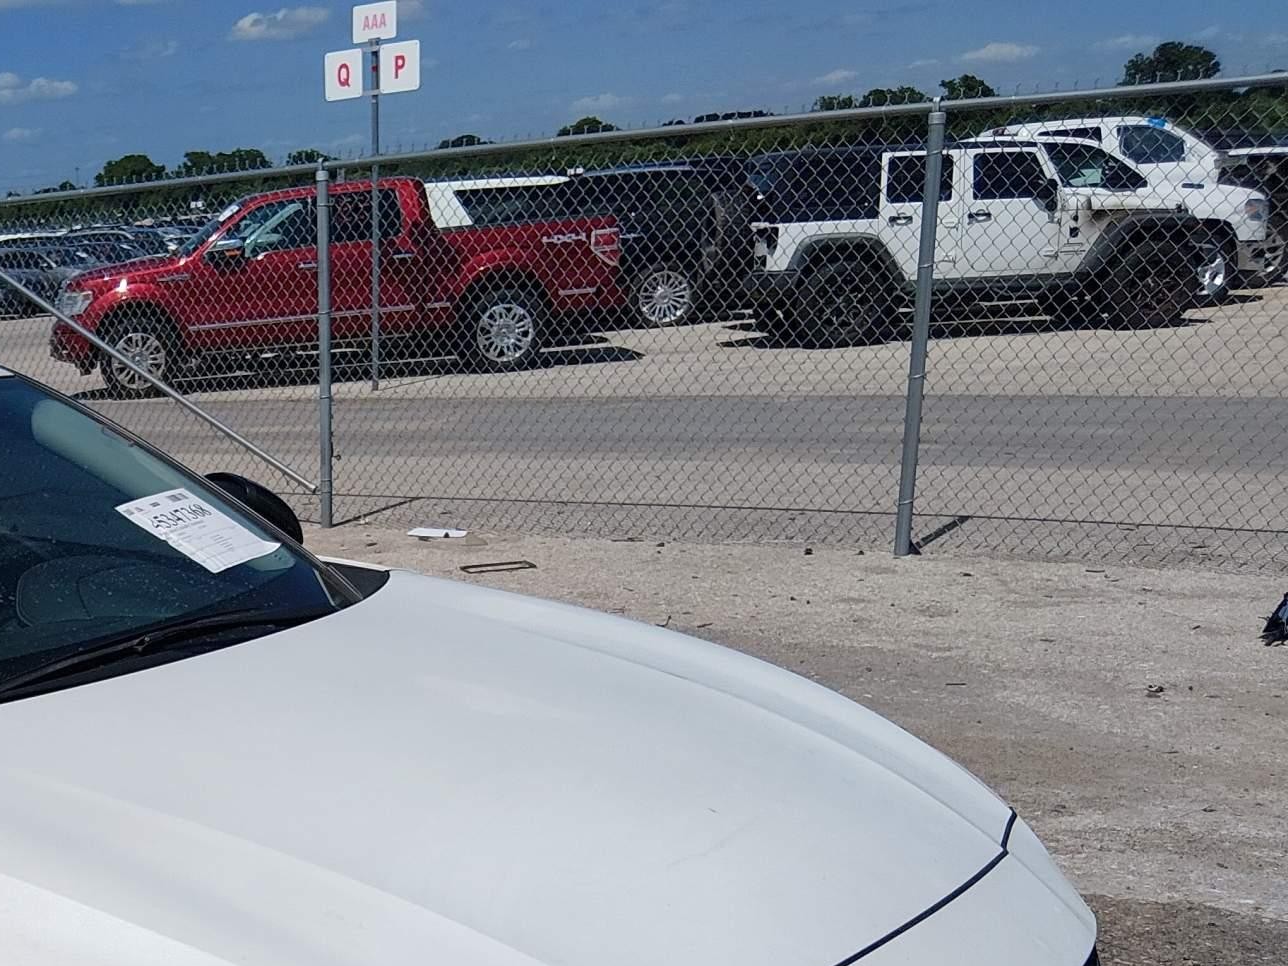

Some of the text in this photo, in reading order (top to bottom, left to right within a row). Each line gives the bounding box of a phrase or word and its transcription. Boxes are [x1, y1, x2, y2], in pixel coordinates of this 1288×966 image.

[362, 13, 387, 31] AAA
[337, 63, 350, 87] Q
[394, 55, 406, 79] P
